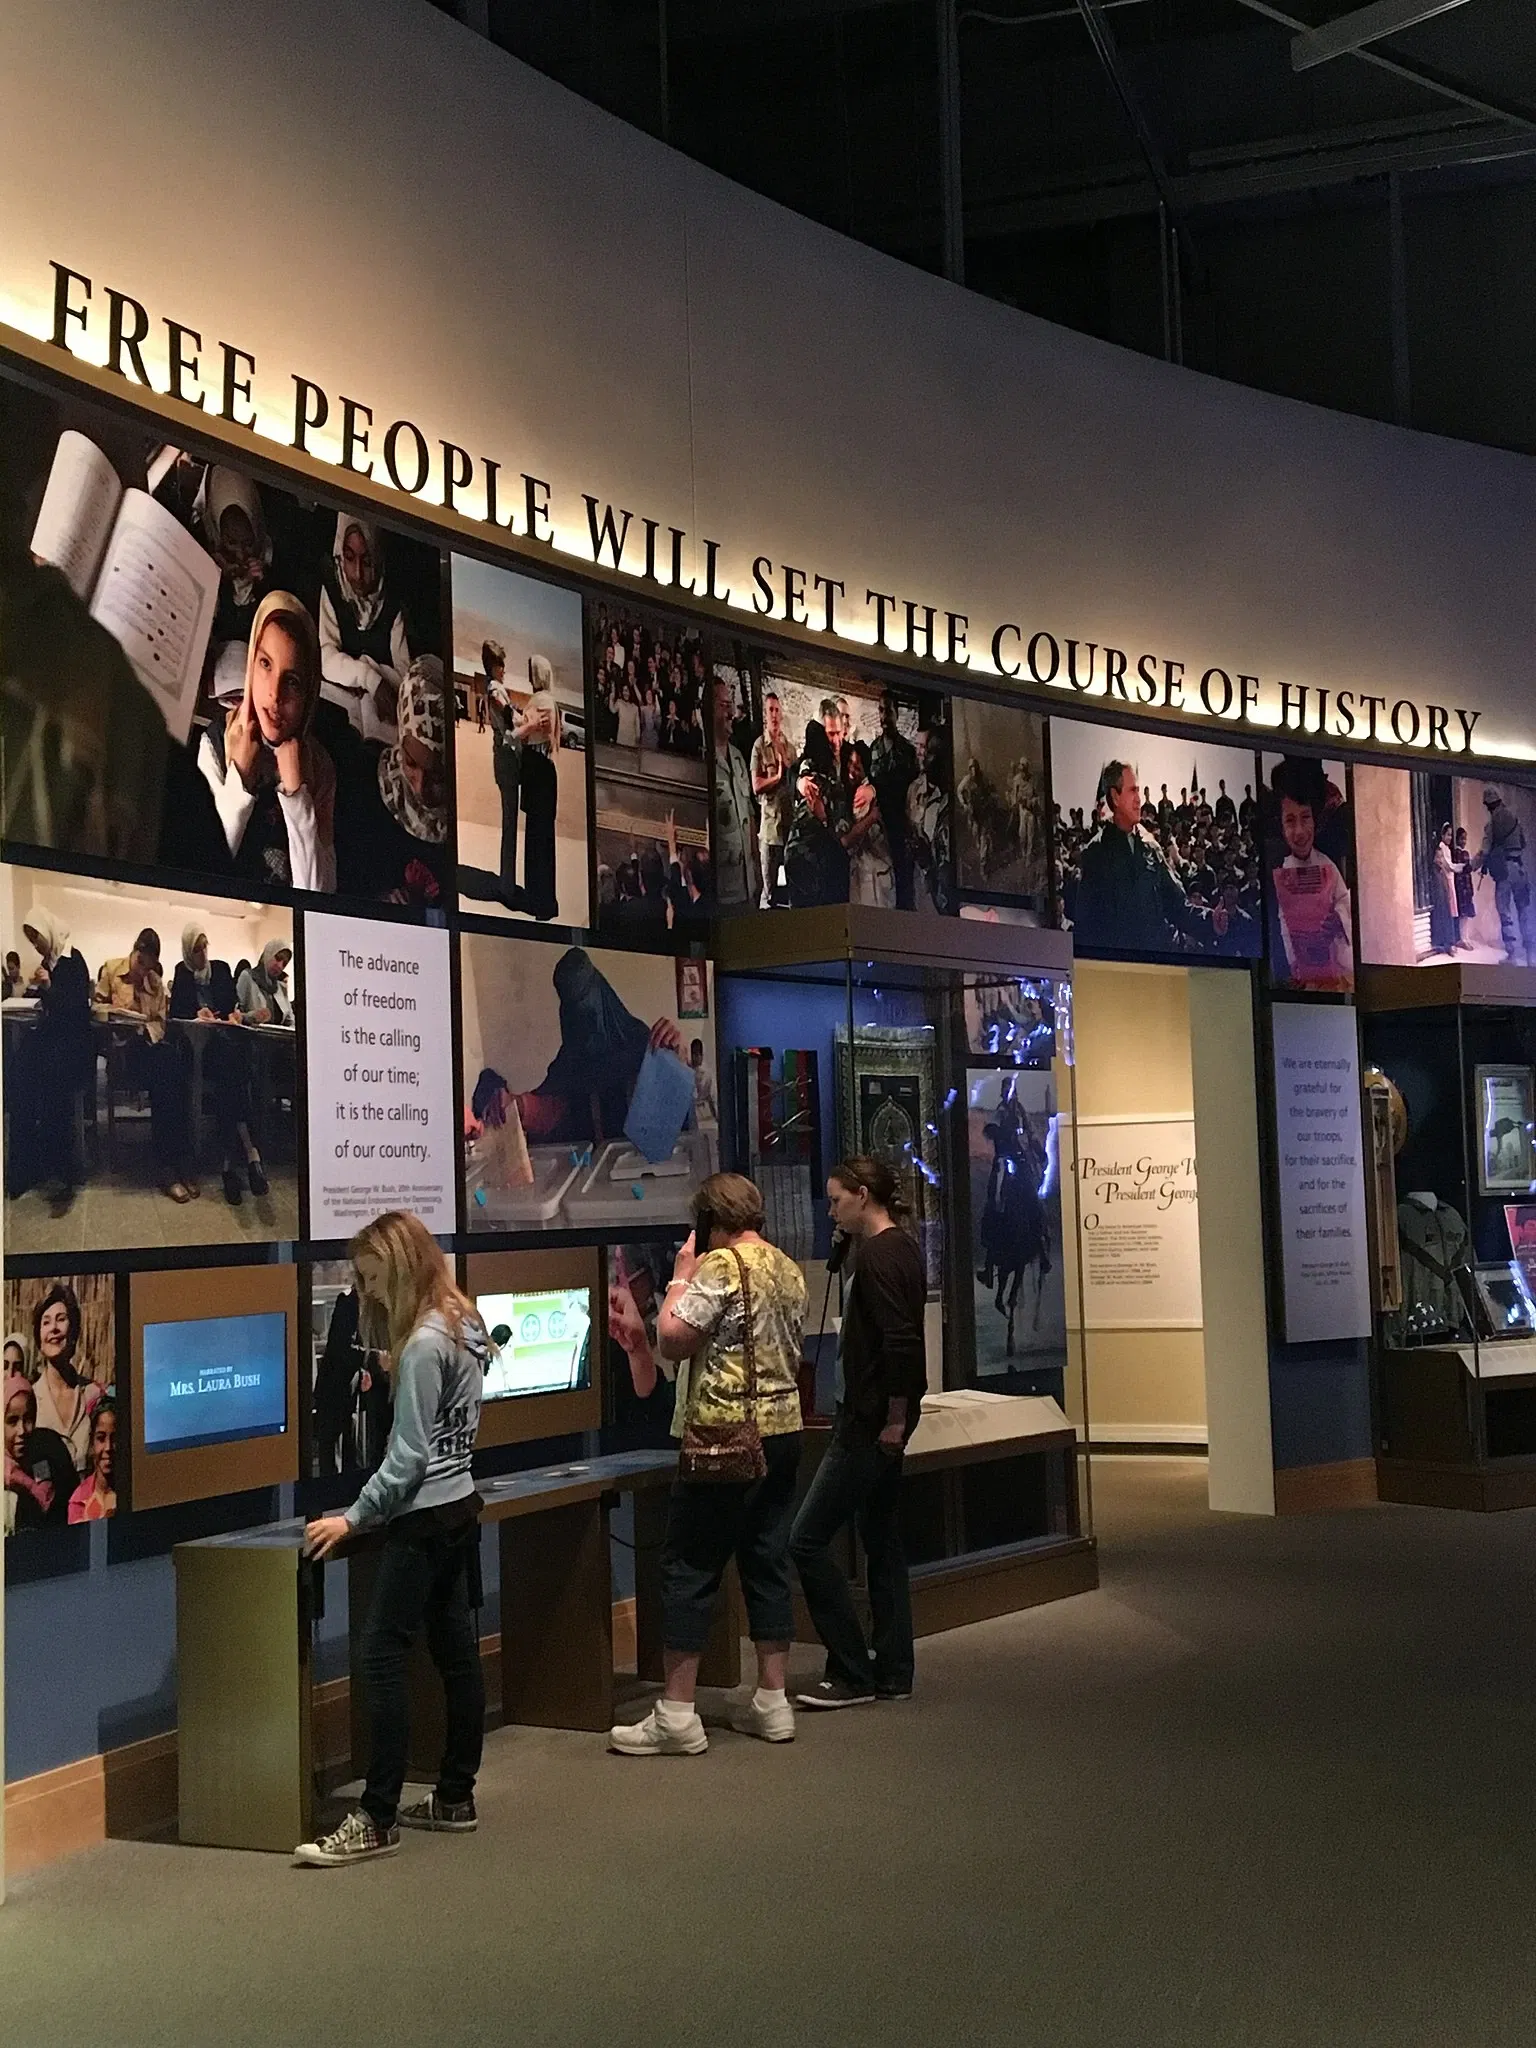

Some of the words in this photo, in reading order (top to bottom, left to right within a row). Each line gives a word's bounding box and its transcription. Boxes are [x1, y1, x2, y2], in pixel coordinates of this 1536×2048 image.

[47, 260, 257, 429] FREE
[289, 374, 554, 546] PEOPLE
[582, 494, 730, 601] WILL
[752, 556, 845, 634] SET
[866, 589, 970, 665] THE
[991, 624, 1185, 708] COURSE
[1200, 668, 1259, 723] OF
[1277, 681, 1482, 755] HISTORY
[338, 949, 364, 969] The
[367, 953, 420, 975] advance
[344, 988, 359, 1006] of
[362, 989, 417, 1011] freedom
[341, 1025, 351, 1044] is
[354, 1026, 376, 1045] the
[379, 1028, 421, 1053] calling
[343, 1063, 358, 1082] of
[361, 1068, 384, 1083] our
[387, 1066, 420, 1087] time;
[1282, 1057, 1297, 1069] We
[1298, 1060, 1312, 1069] are
[1314, 1058, 1351, 1073] eternally
[1293, 1081, 1328, 1096] grateful
[1329, 1081, 1342, 1094] for
[336, 1101, 346, 1120] it
[349, 1102, 359, 1121] is
[362, 1102, 384, 1121] the
[387, 1103, 429, 1126] calling
[1289, 1105, 1304, 1118] the
[1305, 1105, 1338, 1120] bravery
[1338, 1105, 1348, 1118] of
[1296, 1132, 1312, 1142] our
[334, 1139, 349, 1158] of
[353, 1144, 376, 1158] our
[379, 1142, 431, 1163] country.
[1284, 1153, 1298, 1166] for
[1299, 1154, 1320, 1166] their
[1070, 1157, 1133, 1180] President
[1133, 1156, 1180, 1186] George
[1298, 1178, 1315, 1190] and
[1316, 1177, 1330, 1190] for
[1331, 1178, 1346, 1189] the
[1095, 1182, 1156, 1204] President
[1156, 1181, 1197, 1211] Georg
[1299, 1201, 1336, 1214] sacrifices
[1338, 1201, 1348, 1213] of
[1296, 1227, 1316, 1239] their
